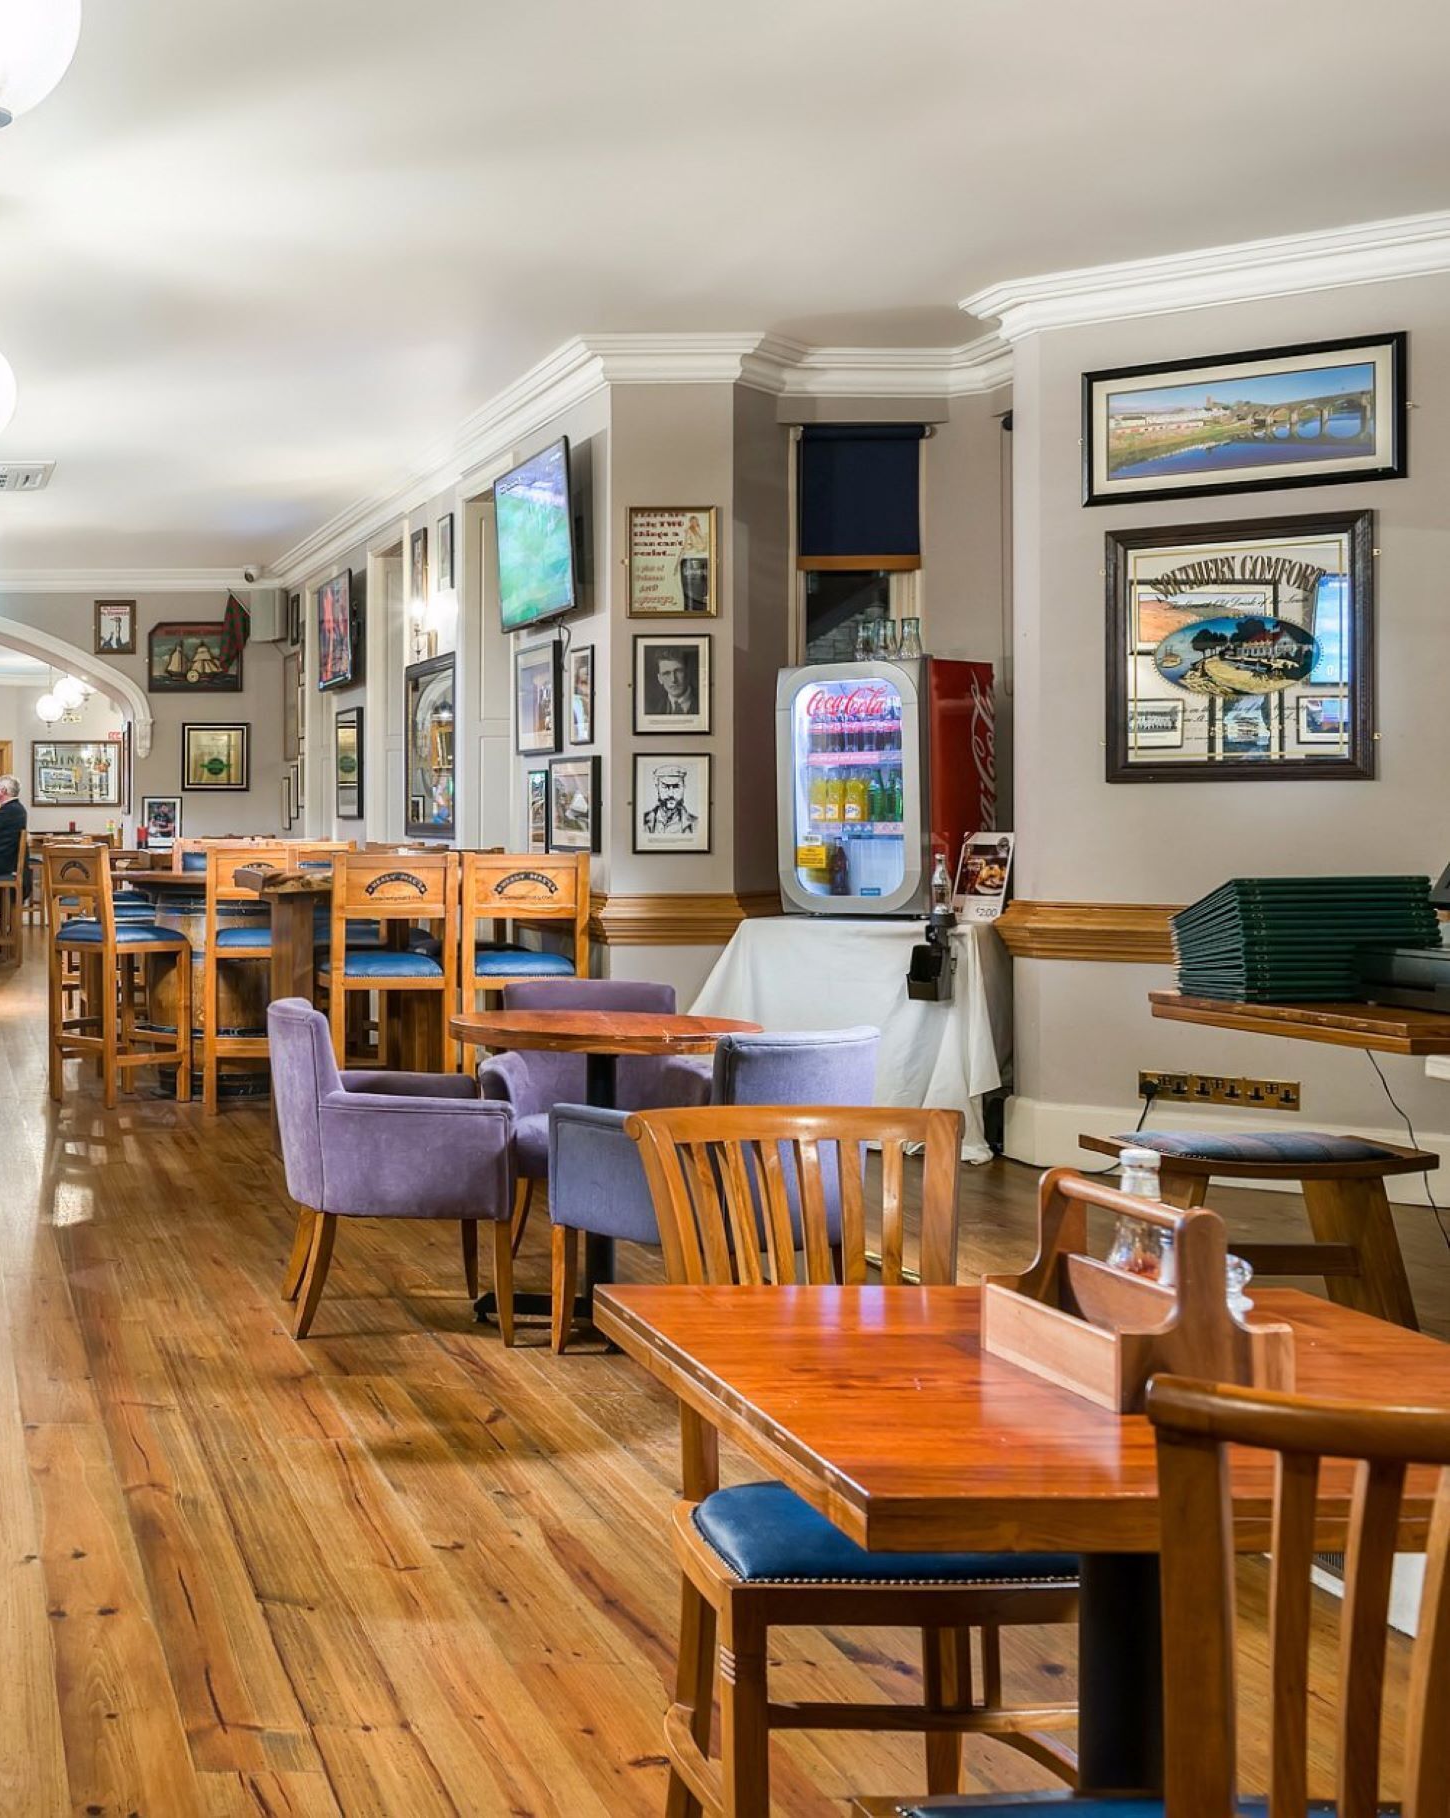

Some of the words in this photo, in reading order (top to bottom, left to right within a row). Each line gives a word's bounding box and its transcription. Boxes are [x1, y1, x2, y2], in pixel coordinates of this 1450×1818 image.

[1150, 555, 1236, 600] SOUTHERN
[1240, 555, 1327, 593] COMFORT
[806, 684, 888, 717] Coca-Cola
